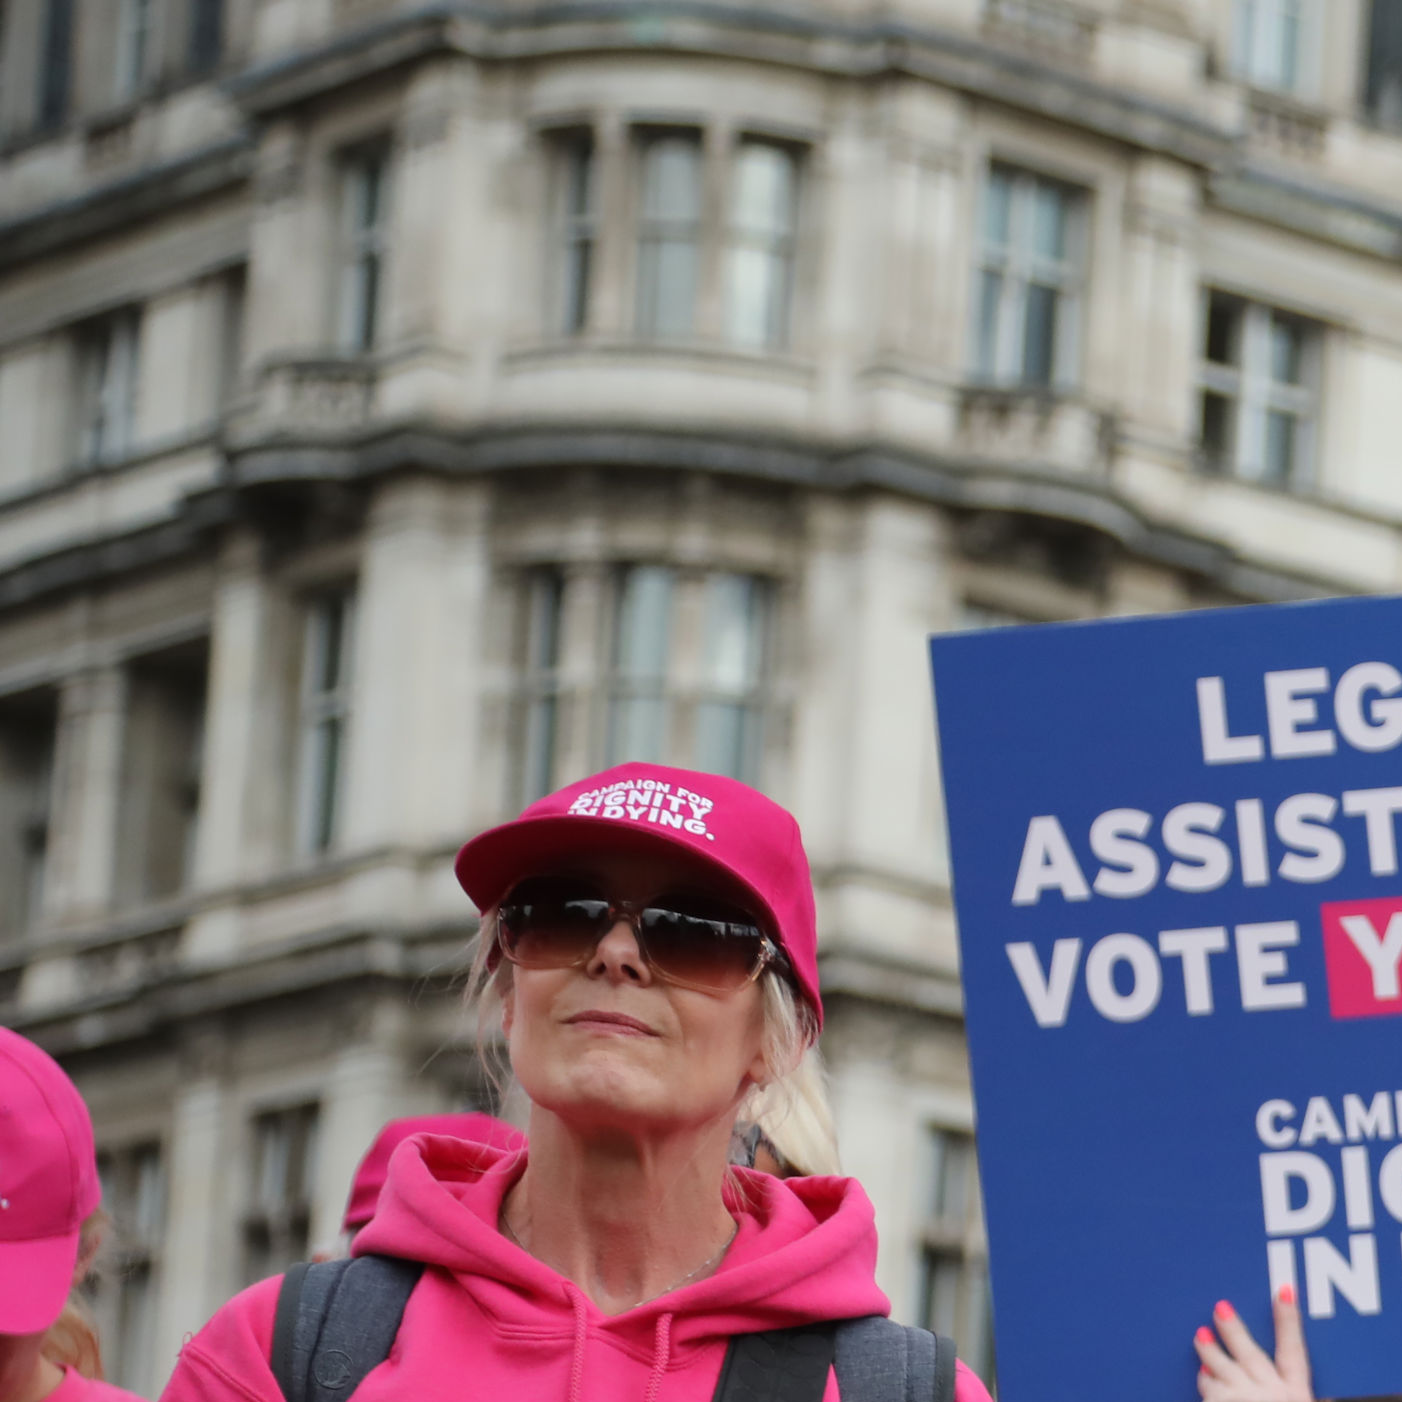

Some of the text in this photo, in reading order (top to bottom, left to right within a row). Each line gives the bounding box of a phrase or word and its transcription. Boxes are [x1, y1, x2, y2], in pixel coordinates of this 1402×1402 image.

[569, 789, 713, 821] DIGNITY
[577, 778, 715, 810] CAMPAIGN FOR
[601, 805, 716, 842] DYING.
[1006, 920, 1306, 1027] VOTE
[1267, 1233, 1382, 1319] IN
